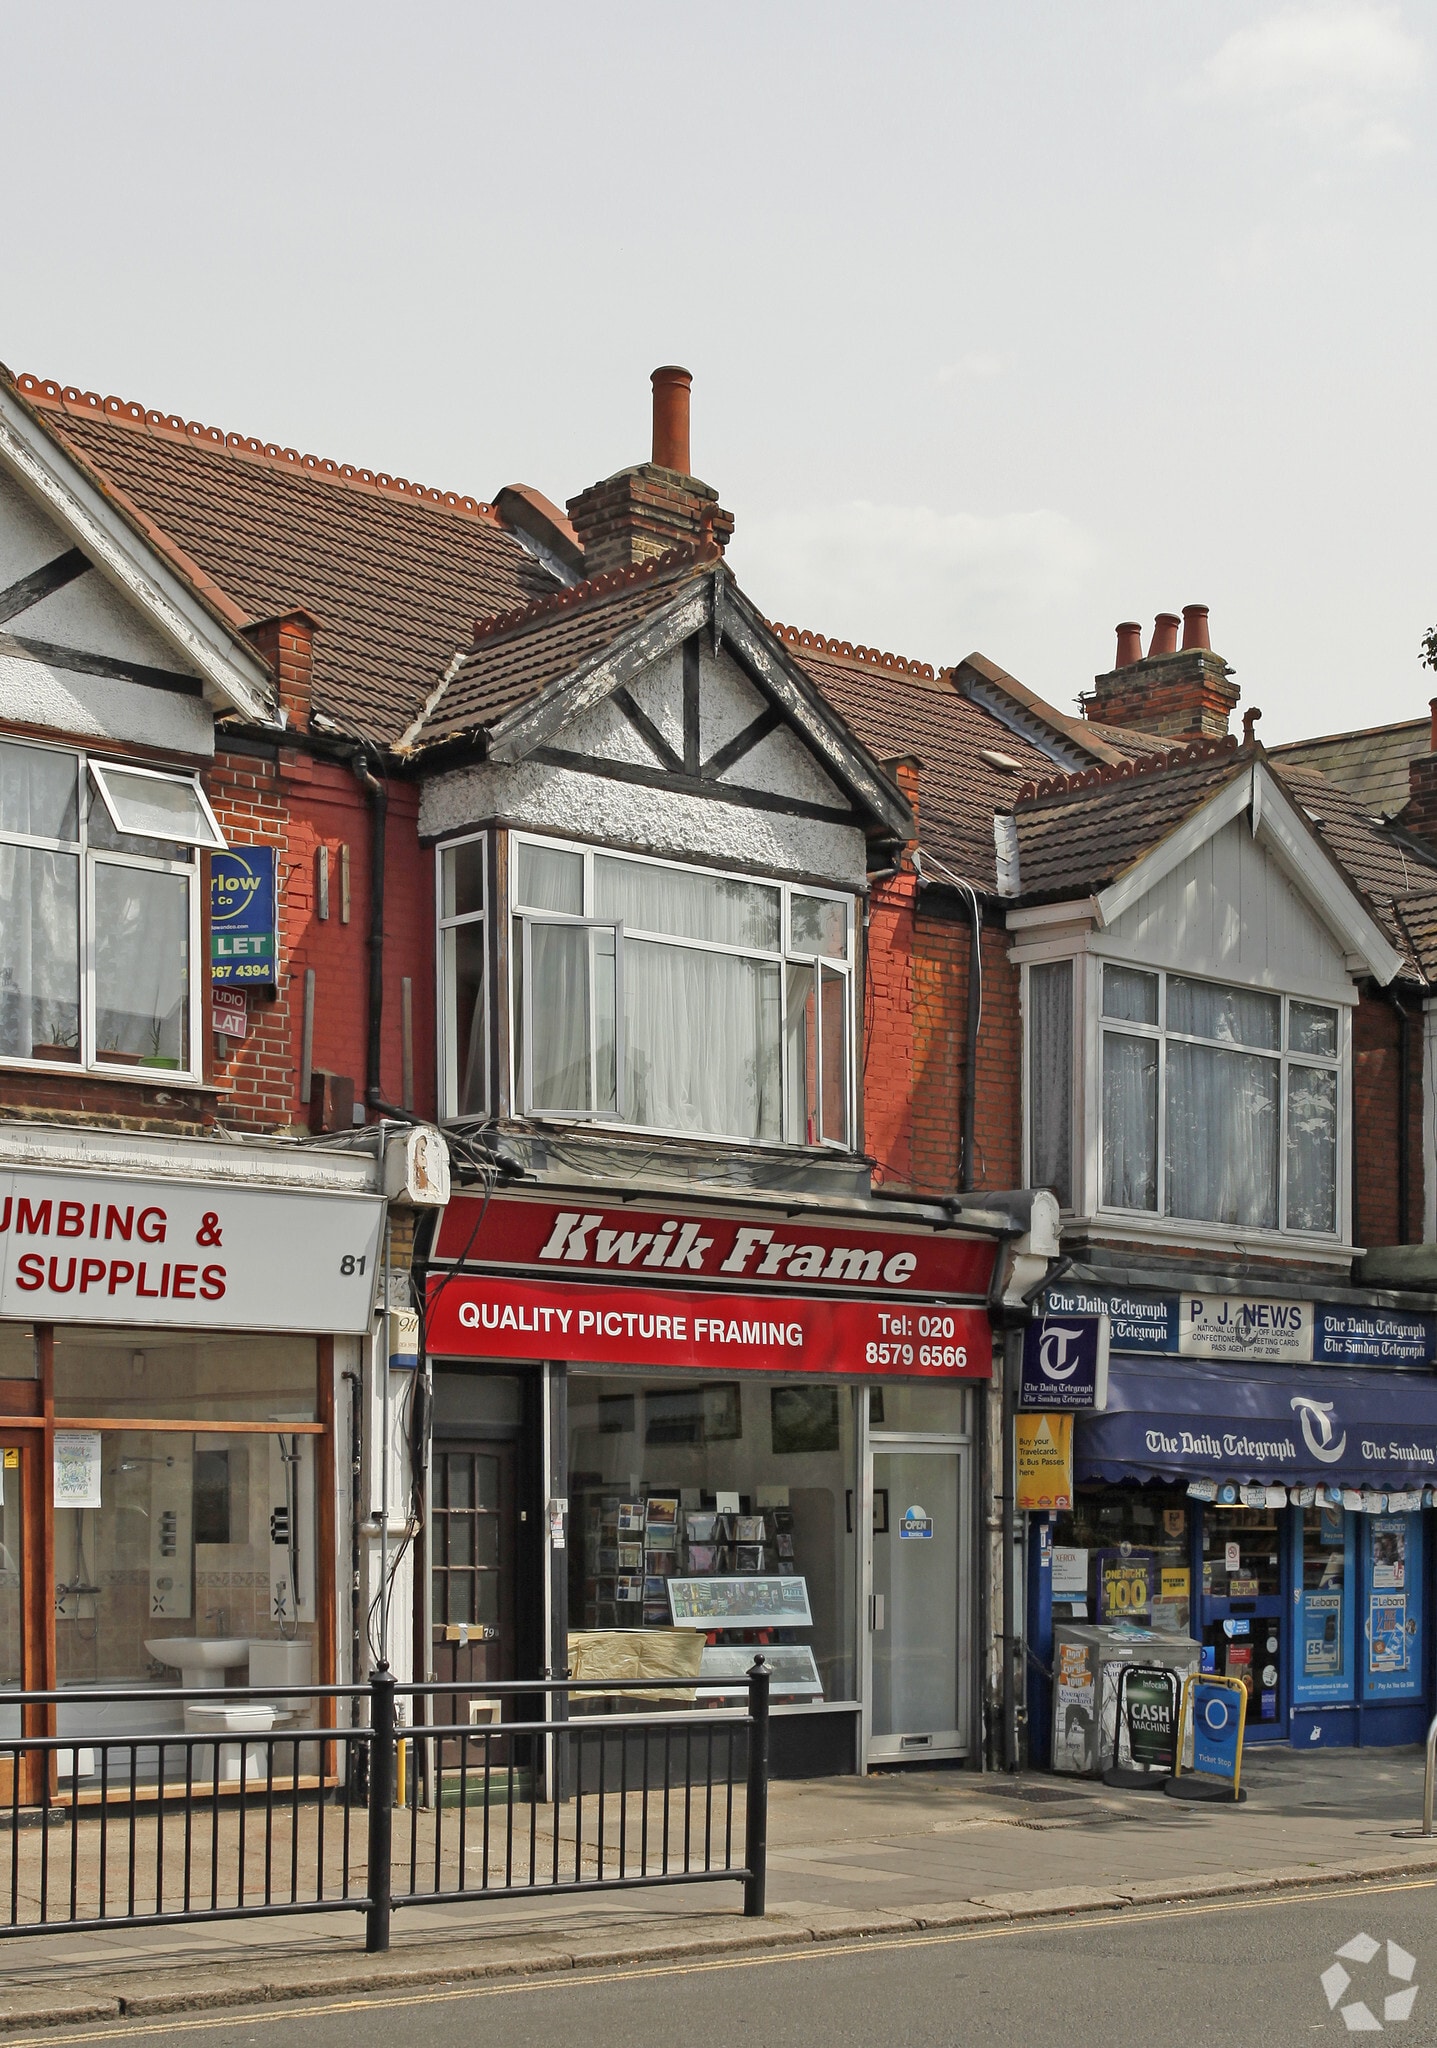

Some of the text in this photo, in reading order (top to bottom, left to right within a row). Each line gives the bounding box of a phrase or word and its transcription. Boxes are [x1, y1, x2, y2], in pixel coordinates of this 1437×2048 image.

[218, 896, 233, 905] Co
[217, 936, 266, 955] LET
[236, 964, 270, 977] 4394
[195, 1211, 223, 1247] &
[539, 1212, 918, 1284] Kwik Frame
[340, 1254, 367, 1276] 81
[15, 1253, 227, 1301] SUPPLIES
[1049, 1292, 1168, 1320] The Daily Telegraph
[458, 1302, 803, 1347] QUALITY PICTURE FRAMING
[878, 1313, 955, 1338] Tel: 020
[1243, 1303, 1302, 1330] NEWS
[1116, 1322, 1168, 1342] Telegraph
[1197, 1325, 1225, 1334] NATIONAL
[1272, 1330, 1295, 1338] LICENCE
[1324, 1315, 1426, 1341] The Daily Telegraph
[1211, 1344, 1227, 1352] PASS
[1228, 1345, 1247, 1353] AGENT
[1265, 1347, 1281, 1355] ZONE
[1280, 1338, 1300, 1347] CARDS
[1324, 1338, 1426, 1359] The Sunday Telegraph
[865, 1342, 967, 1368] 8579 6566
[1019, 1438, 1049, 1446] Buy your
[1145, 1430, 1296, 1461] The Daily Telegraph
[1019, 1458, 1065, 1466] & Bus Passes
[1361, 1440, 1435, 1465] The Sunday
[905, 1520, 926, 1530] OPEN
[1105, 1569, 1121, 1580] ONE
[1106, 1579, 1146, 1610] 100
[1311, 1598, 1339, 1607] Lebara
[1379, 1596, 1405, 1606] Lebara
[1308, 1642, 1321, 1656] £5
[1142, 1680, 1169, 1691] Infocash
[1131, 1703, 1170, 1723] CASH
[1132, 1721, 1171, 1734] MACHINE
[1198, 1753, 1232, 1768] Ticket Stop
